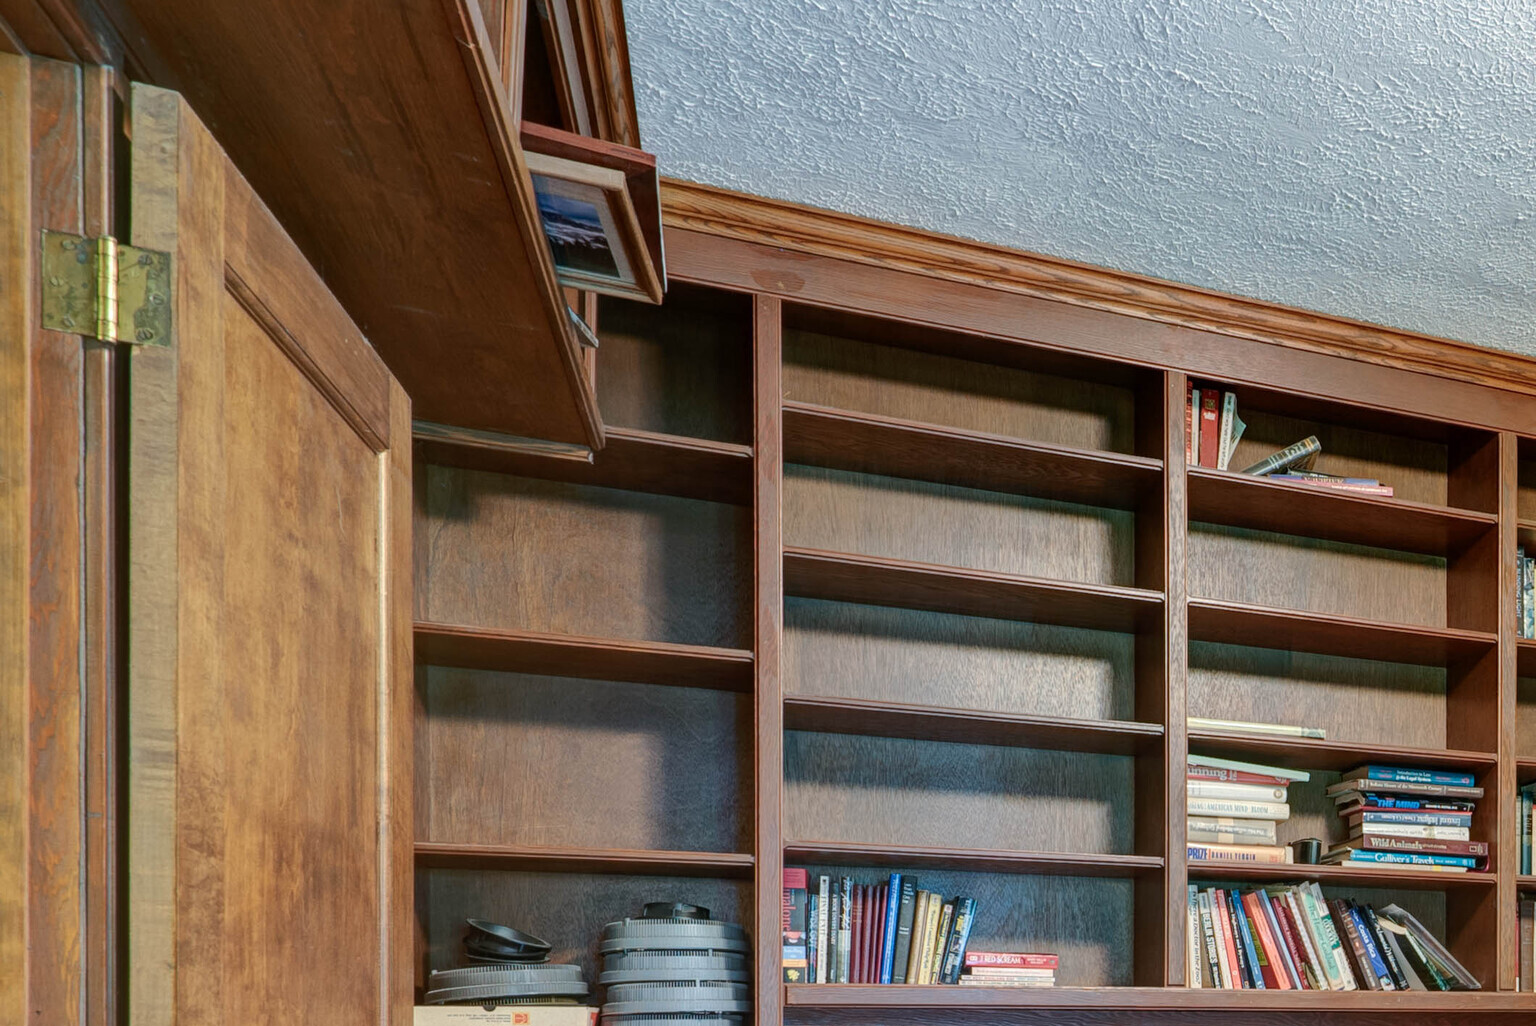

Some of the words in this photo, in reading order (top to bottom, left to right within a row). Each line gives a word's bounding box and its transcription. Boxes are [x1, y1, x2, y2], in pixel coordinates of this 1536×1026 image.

[1207, 803, 1232, 812] AMERICAN
[1251, 805, 1268, 814] BLOOM
[1377, 800, 1394, 808] THE
[1396, 801, 1420, 809] MIND
[1370, 837, 1389, 847] Wild
[1389, 839, 1422, 850] Animals
[1187, 848, 1207, 860] PRIZE
[1375, 853, 1410, 863] Gulliver's
[1411, 855, 1434, 864] Travels
[1203, 913, 1214, 936] BERLIN
[1357, 924, 1370, 944] Costa
[1365, 944, 1377, 958] Rica
[1206, 937, 1218, 963] STORIES
